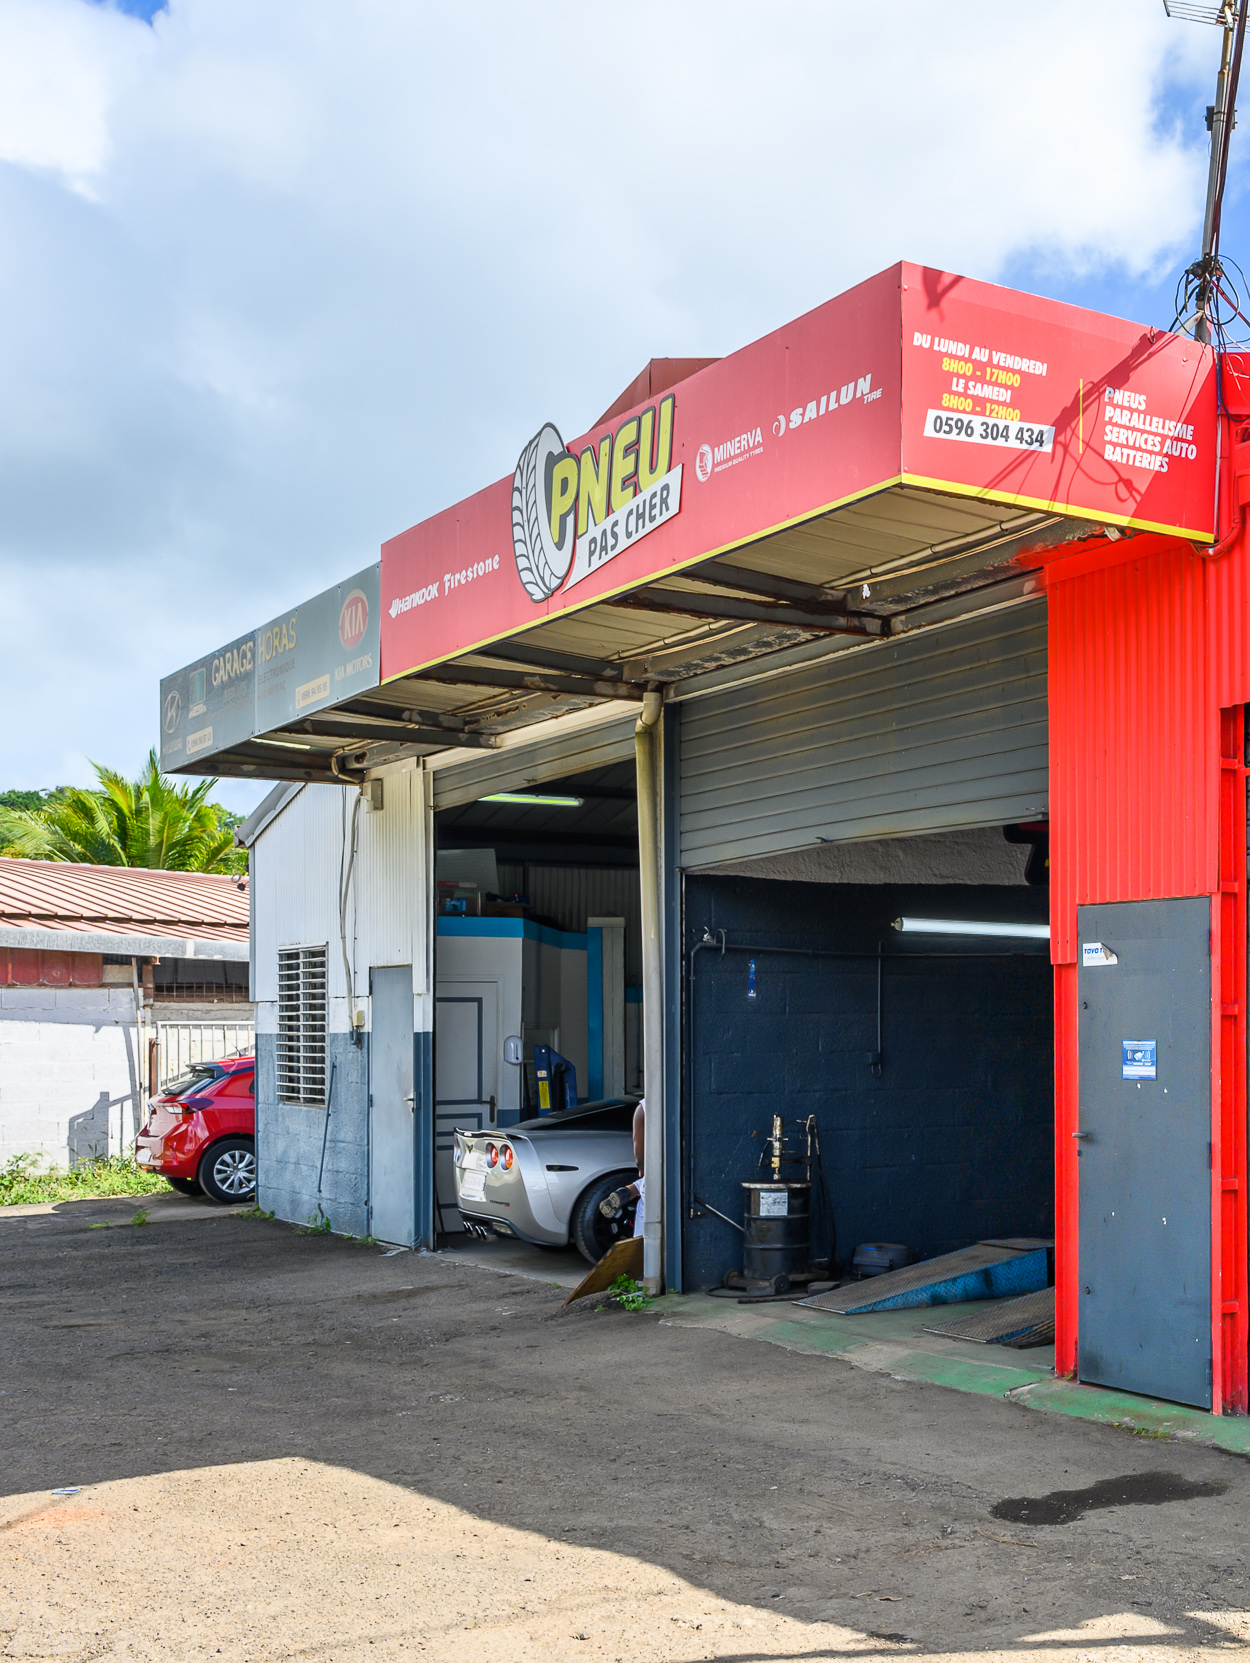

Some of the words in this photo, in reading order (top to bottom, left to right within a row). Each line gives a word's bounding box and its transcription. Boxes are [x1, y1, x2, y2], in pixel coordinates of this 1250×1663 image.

[913, 332, 931, 348] DU
[933, 337, 970, 358] LUNDI
[972, 347, 989, 362] AU
[992, 351, 1047, 376] VENDREDI
[942, 357, 973, 376] 8H00
[986, 367, 1020, 387] 17H00
[789, 373, 871, 429] SAILUN
[864, 388, 882, 404] TIRE
[942, 393, 972, 412] 8H00
[986, 402, 1020, 422] 12H00
[952, 377, 965, 392] LE
[967, 381, 1011, 403] SAMEDI
[1104, 386, 1146, 410] PNEUS
[933, 415, 974, 438] 0596
[980, 421, 1010, 442] 304
[1015, 427, 1044, 447] 434
[1104, 405, 1194, 440] PARALLELISME
[714, 427, 762, 464] MINERVA
[1104, 425, 1161, 452] SERVICES
[1163, 438, 1197, 460] AUTO
[1104, 444, 1169, 473] BATTERIES
[548, 394, 675, 549] PNEU
[588, 520, 619, 568] PAS
[625, 483, 670, 540] CHER
[443, 554, 500, 596] Firestone
[344, 602, 364, 640] KIA
[212, 641, 254, 686] GARAGE
[258, 617, 296, 665] HORAS
[346, 652, 373, 677] MOTORS
[1084, 947, 1104, 955] TOYOT
